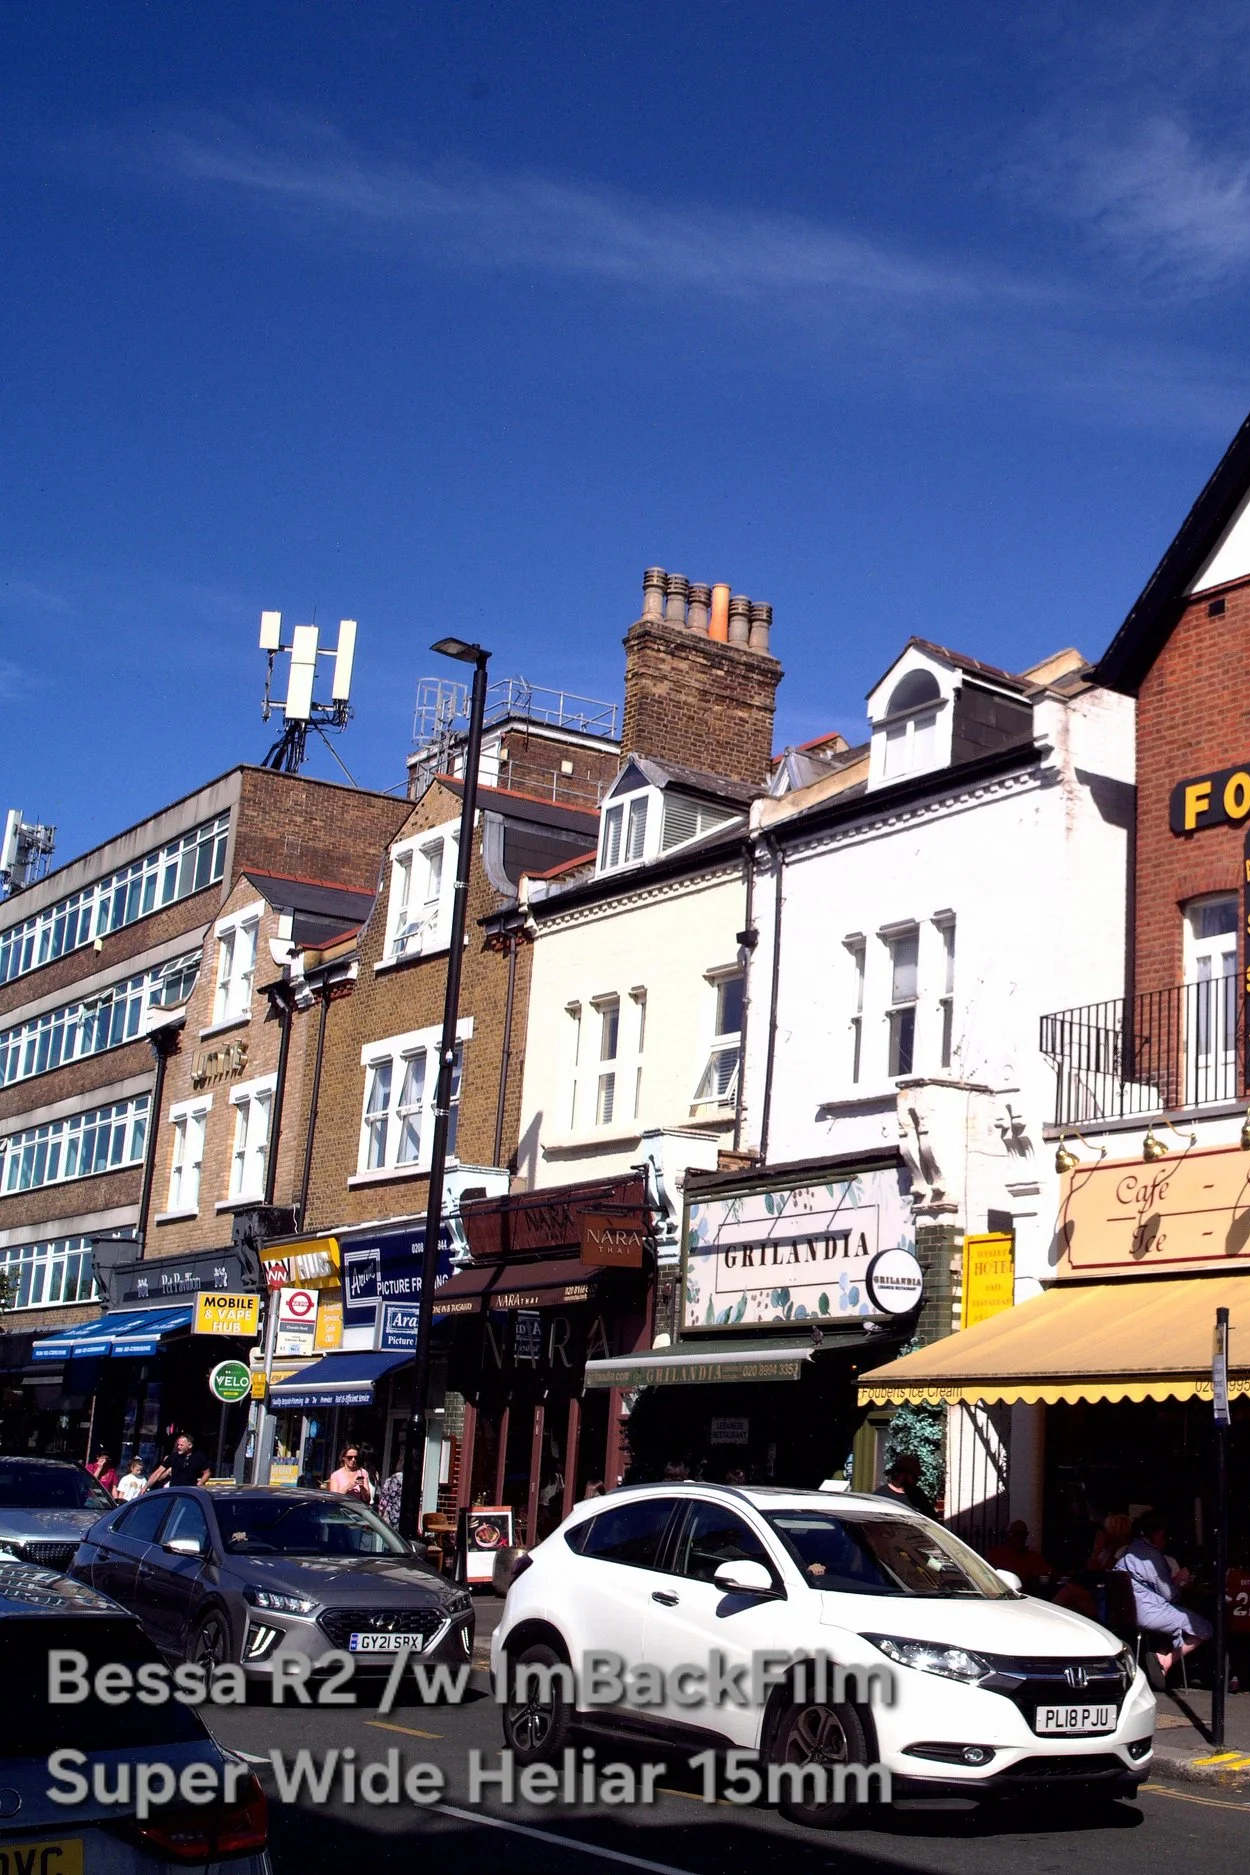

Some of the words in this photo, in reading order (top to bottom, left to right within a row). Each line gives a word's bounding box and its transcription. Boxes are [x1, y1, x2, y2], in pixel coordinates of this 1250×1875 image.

[586, 1228, 641, 1247] NARA
[1128, 1223, 1167, 1254] Ice
[599, 1246, 630, 1255] THAI
[724, 1231, 870, 1269] GRILANDIA
[268, 1270, 287, 1282] NN
[873, 1275, 922, 1287] GRILANDIA
[377, 1279, 410, 1295] PICTURE
[203, 1297, 254, 1309] MOBILE
[496, 1294, 521, 1307] NARA
[204, 1310, 212, 1319] &
[218, 1309, 251, 1321] VAPE
[393, 1313, 420, 1328] Ara
[212, 1322, 241, 1333] HUB
[388, 1335, 414, 1346] Picture
[646, 1365, 722, 1383] GRILANDIA
[215, 1376, 249, 1387] VELO
[927, 1384, 963, 1397] Cream
[361, 1636, 391, 1649] GY21
[1045, 1709, 1078, 1729] PL18
[1082, 1708, 1108, 1728] PJU
